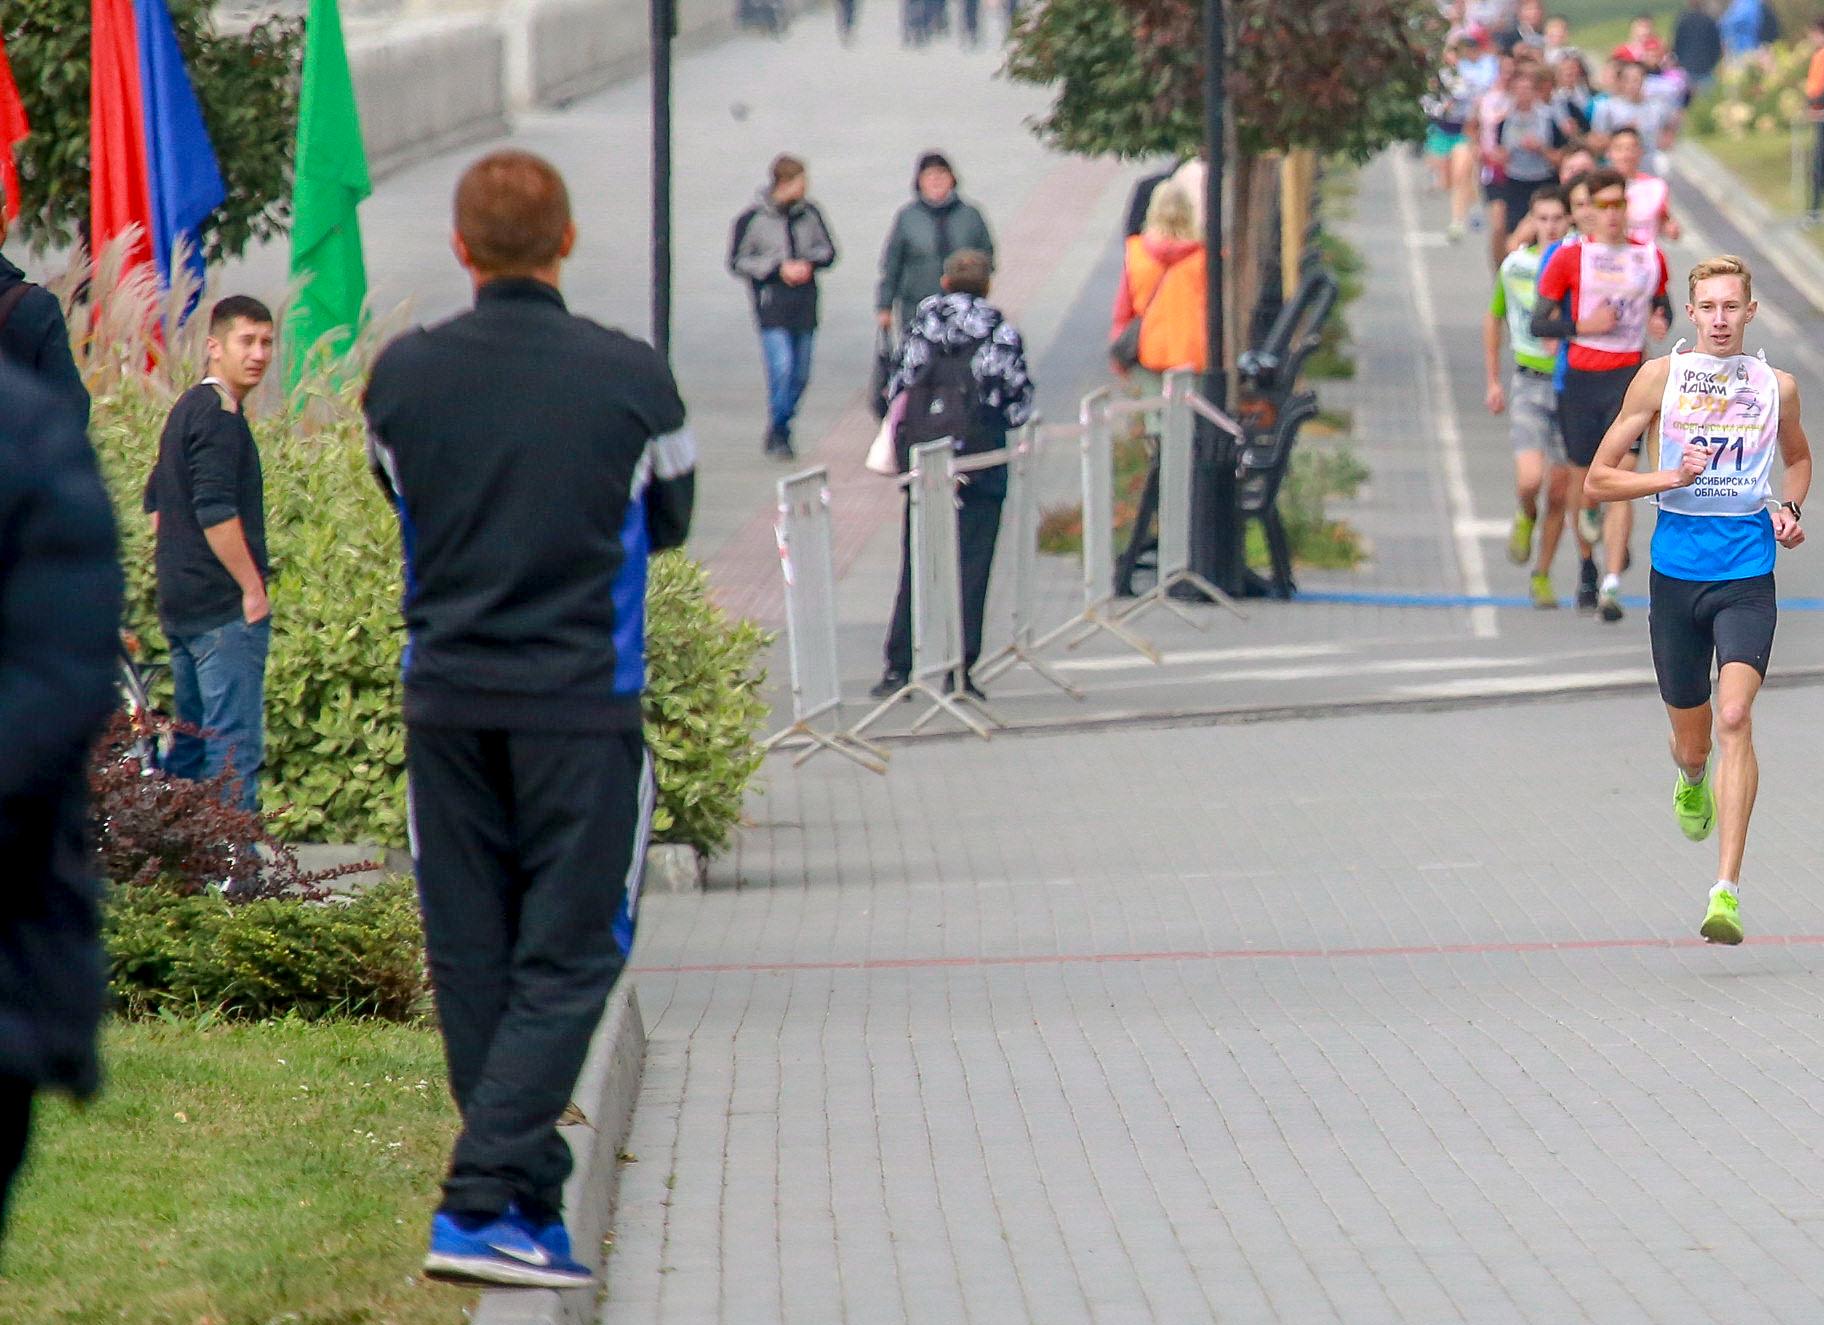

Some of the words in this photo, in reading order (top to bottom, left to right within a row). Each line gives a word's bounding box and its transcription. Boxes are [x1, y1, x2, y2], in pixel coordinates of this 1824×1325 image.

[1680, 382, 1727, 396] НАЦИИ
[1694, 476, 1757, 486] ОСИБИРСКАЯ
[1694, 488, 1738, 497] ОБЛАСТЬ
